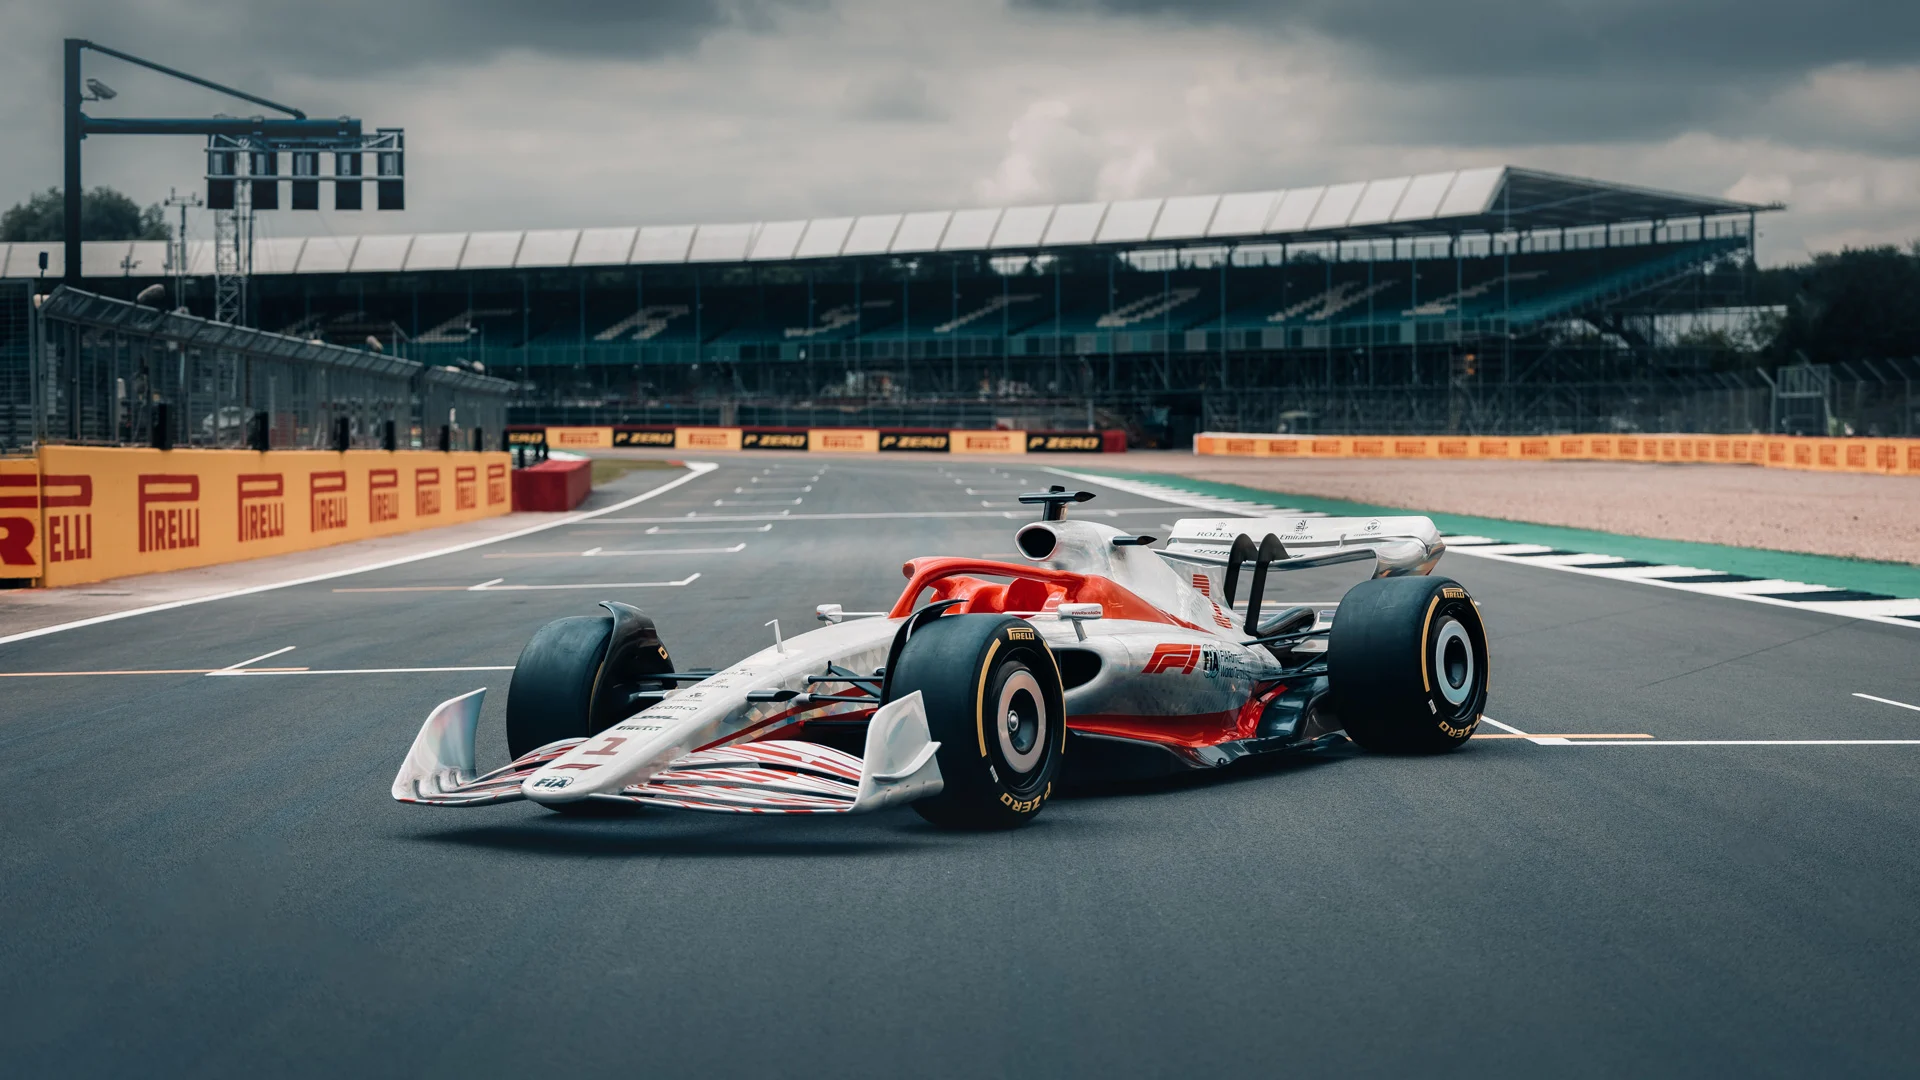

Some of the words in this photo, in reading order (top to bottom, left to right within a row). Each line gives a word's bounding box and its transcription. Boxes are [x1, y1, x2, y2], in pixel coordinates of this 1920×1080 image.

[615, 433, 628, 443] P
[630, 432, 674, 444] ZERO
[744, 434, 758, 445] P
[759, 434, 806, 447] ZERO
[881, 436, 896, 448] P
[898, 436, 947, 448] ZERO
[1028, 437, 1045, 449] P
[1045, 437, 1099, 449] ZERO
[237, 473, 285, 542] PIRELLI
[310, 471, 348, 533] PIRELLI
[138, 474, 200, 553] PIRELLI
[1442, 587, 1465, 599] PIRELLI
[1007, 627, 1035, 641] PIRELLI
[1438, 720, 1471, 738] ZERO
[534, 778, 568, 788] FIA
[1044, 781, 1052, 800] P
[1000, 792, 1042, 813] ZERO
